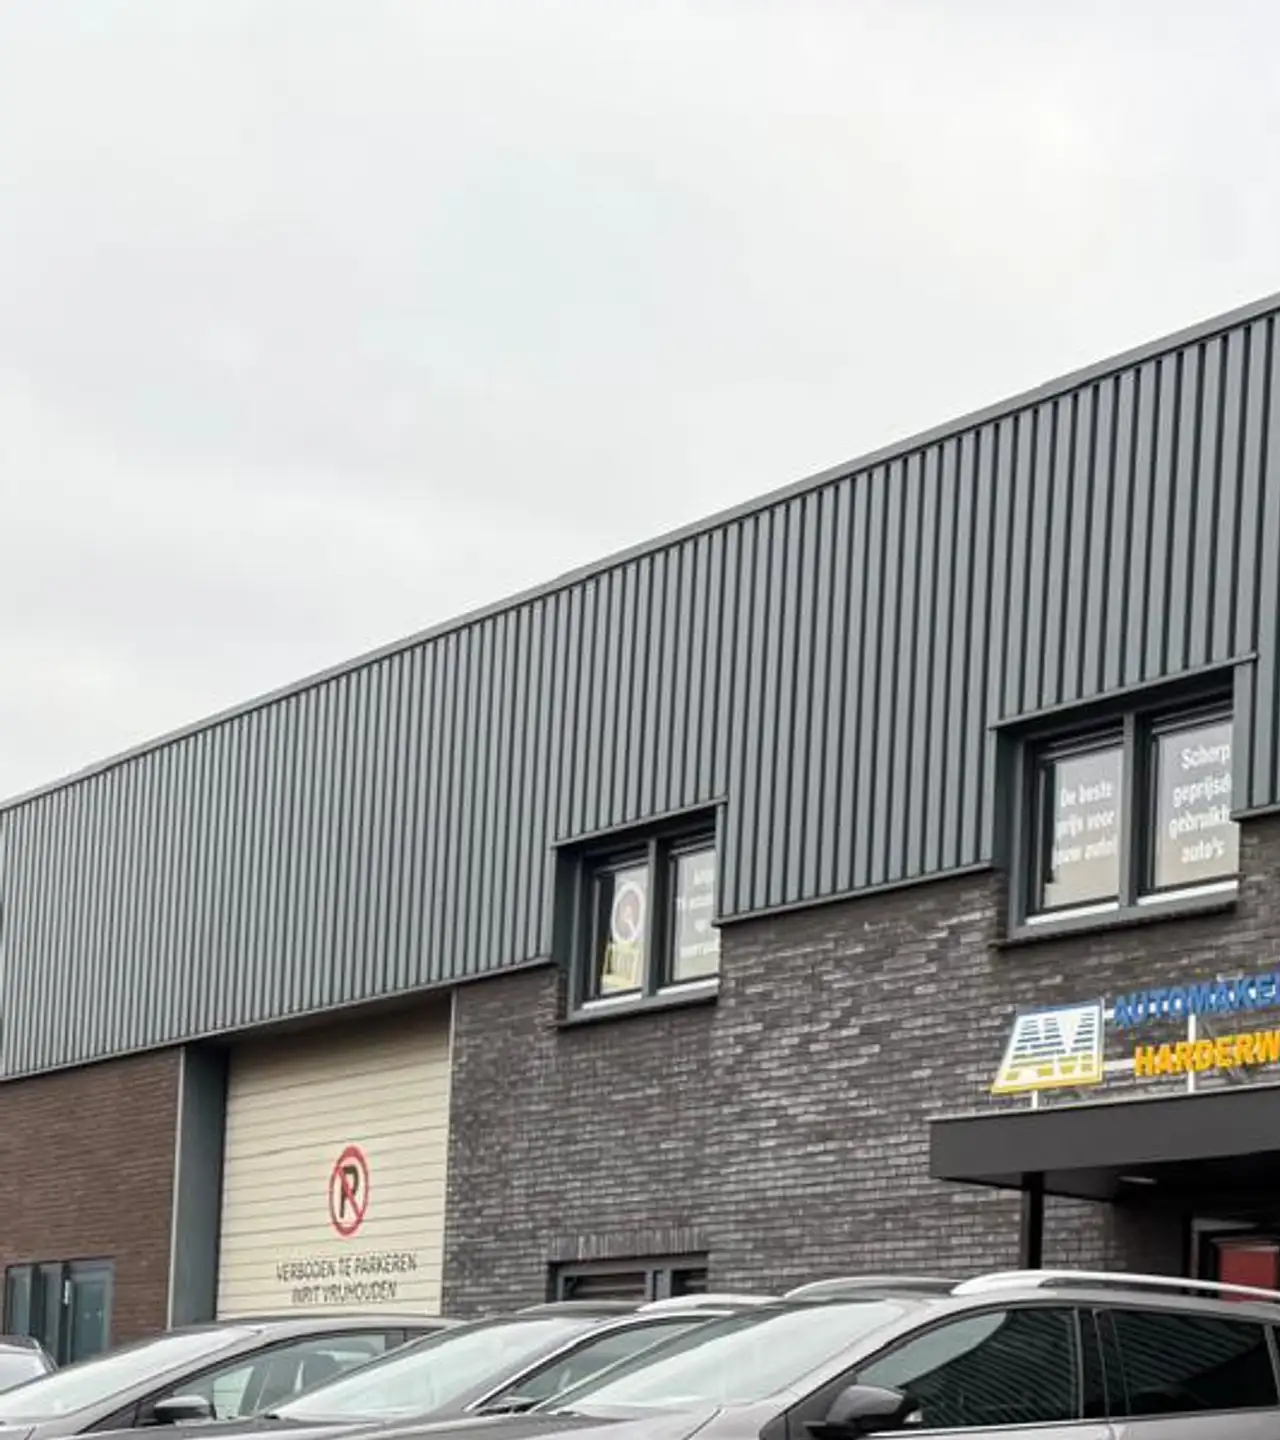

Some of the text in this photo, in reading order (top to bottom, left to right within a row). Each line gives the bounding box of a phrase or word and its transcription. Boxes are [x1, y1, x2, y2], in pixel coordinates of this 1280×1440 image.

[1181, 744, 1230, 769] Scherp
[1061, 780, 1113, 808] De beste
[1181, 836, 1225, 864] auto's
